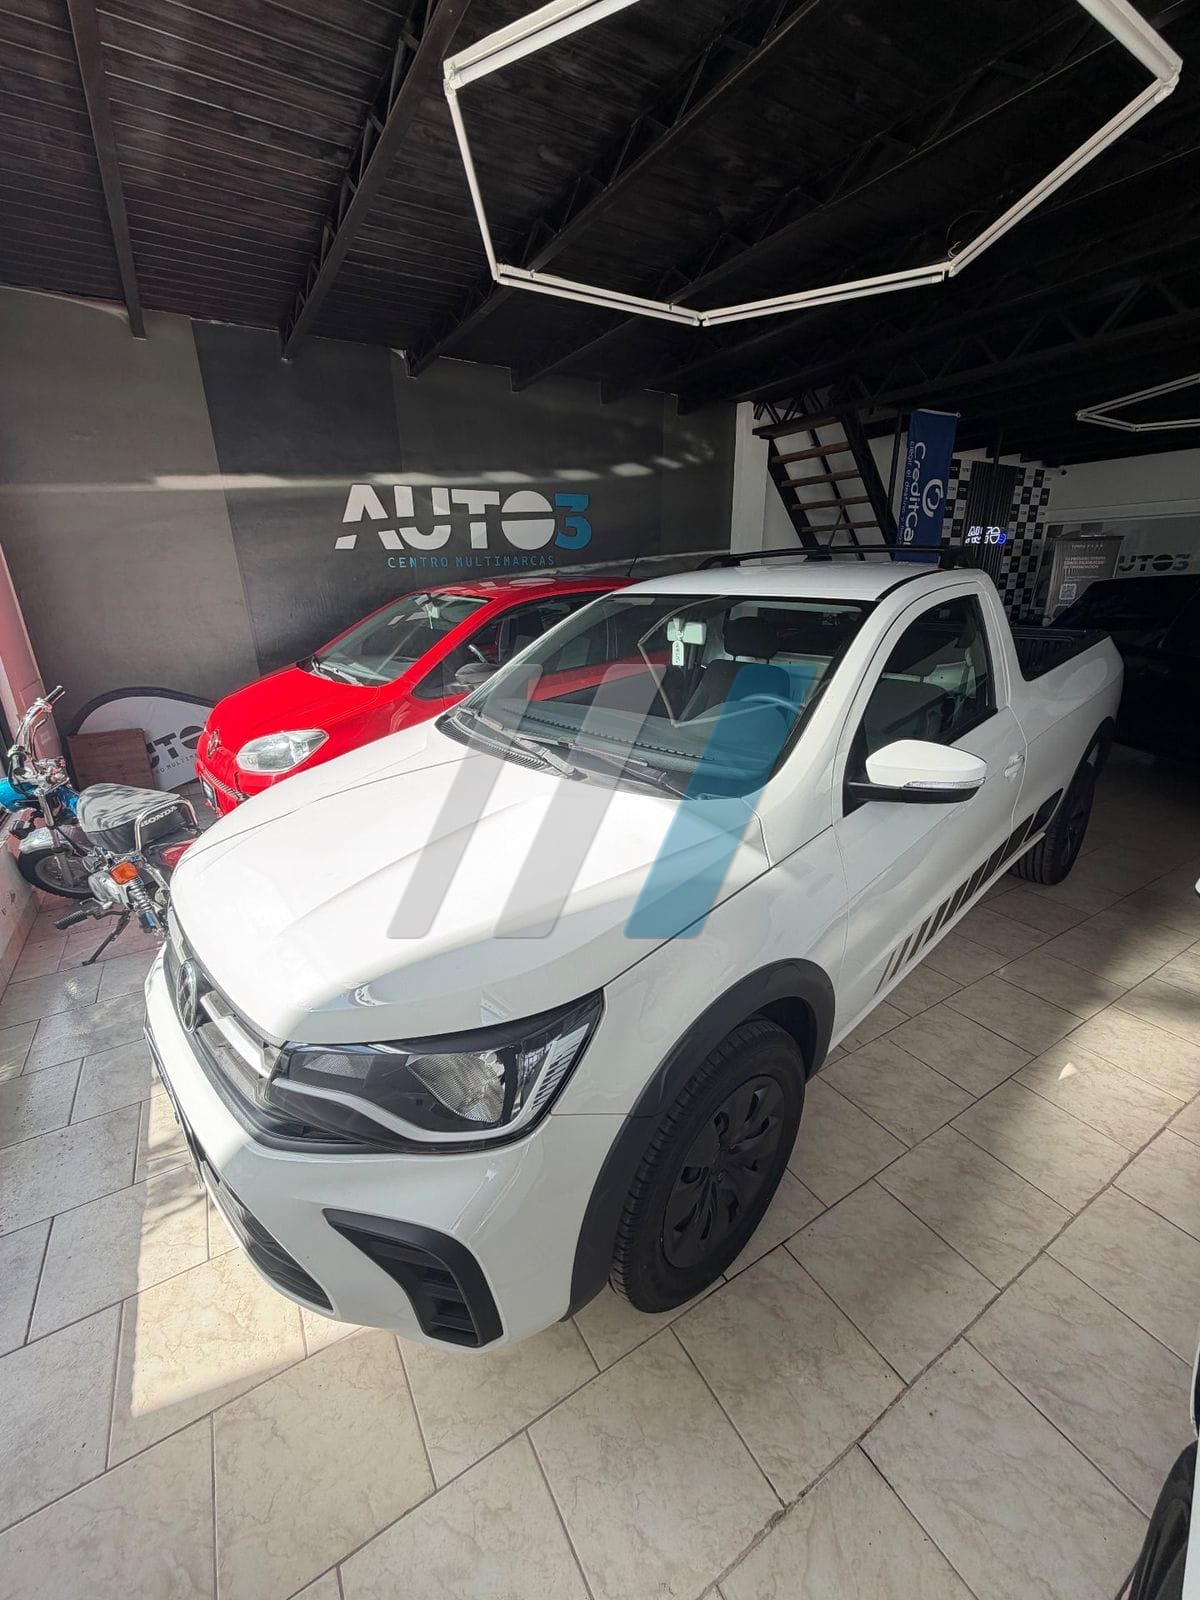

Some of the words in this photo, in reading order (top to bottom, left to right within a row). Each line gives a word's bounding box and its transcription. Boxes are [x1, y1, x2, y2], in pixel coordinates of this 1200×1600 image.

[334, 484, 592, 550] AUTO3
[387, 555, 448, 568] CENTRO
[455, 555, 555, 568] MULTIMARCAS
[1119, 554, 1190, 571] UTO3
[140, 805, 178, 828] HONDA
